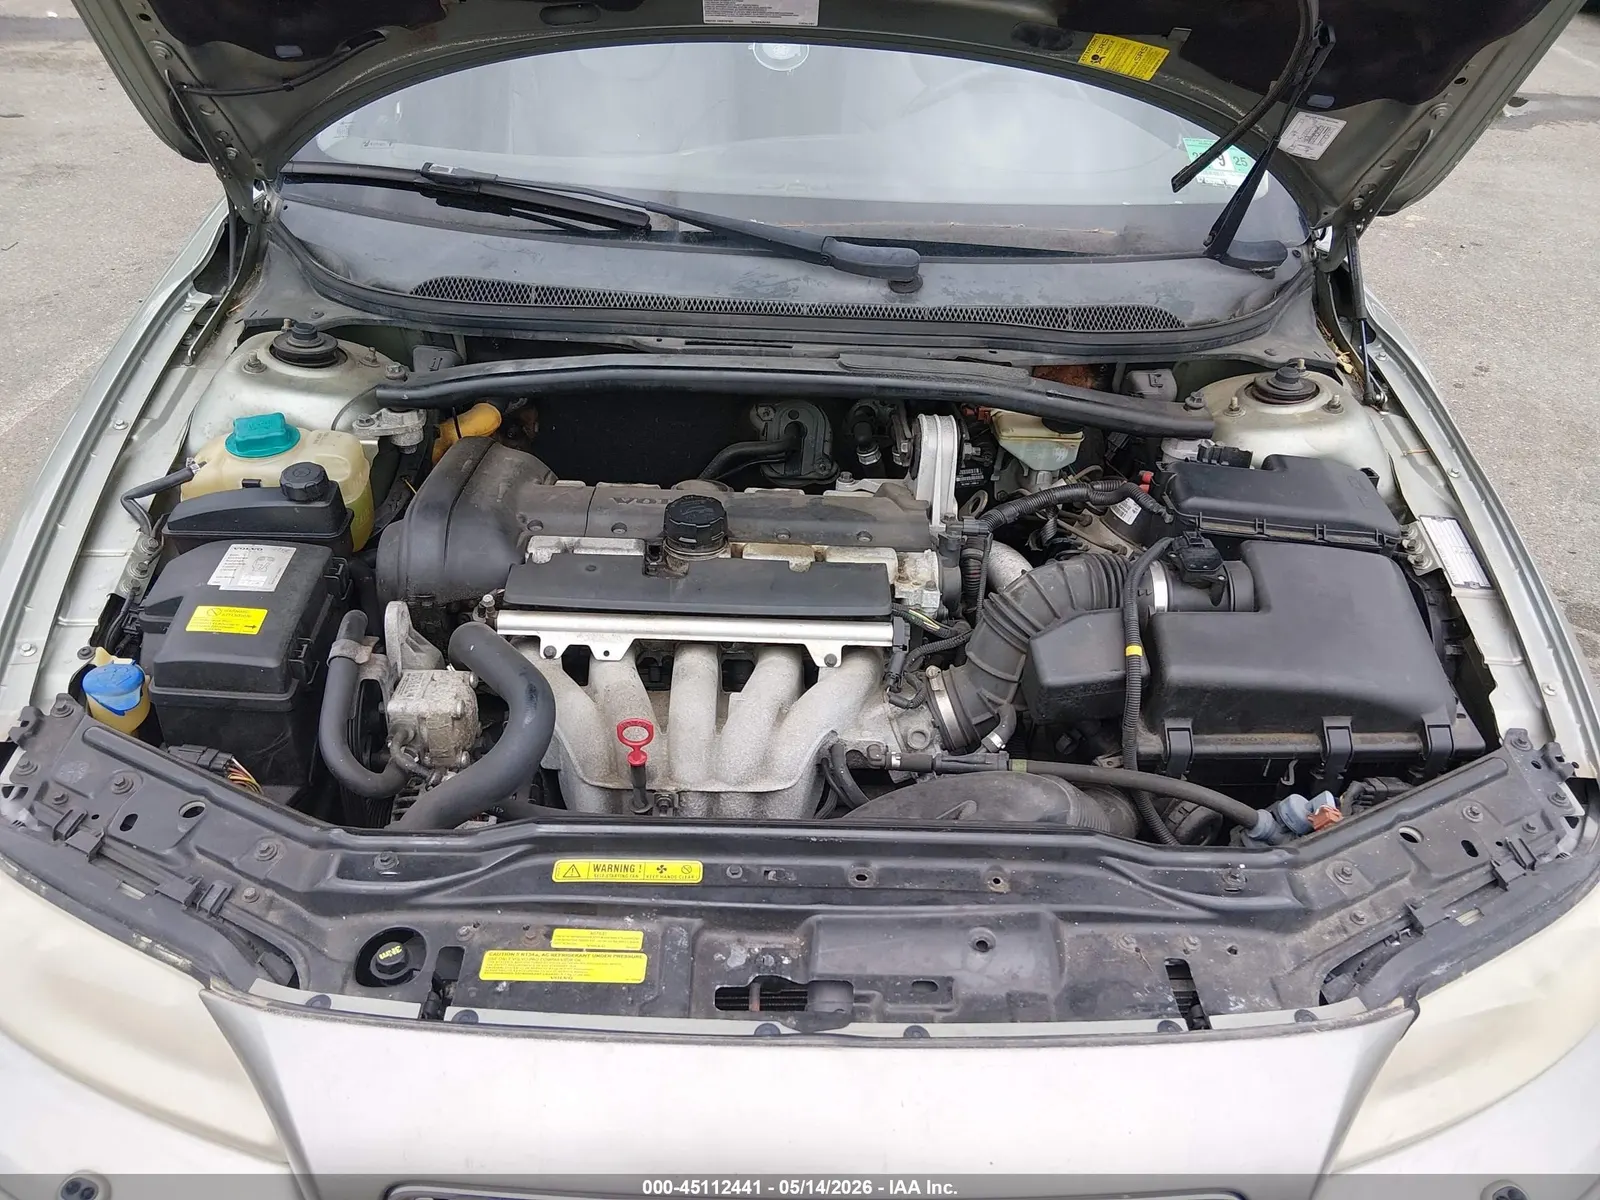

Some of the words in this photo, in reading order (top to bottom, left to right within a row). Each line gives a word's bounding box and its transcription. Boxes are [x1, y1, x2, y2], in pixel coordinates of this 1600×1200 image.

[1095, 38, 1109, 54] SRS
[1134, 46, 1148, 61] SRS
[1232, 155, 1248, 167] 25
[593, 863, 635, 873] WARNING
